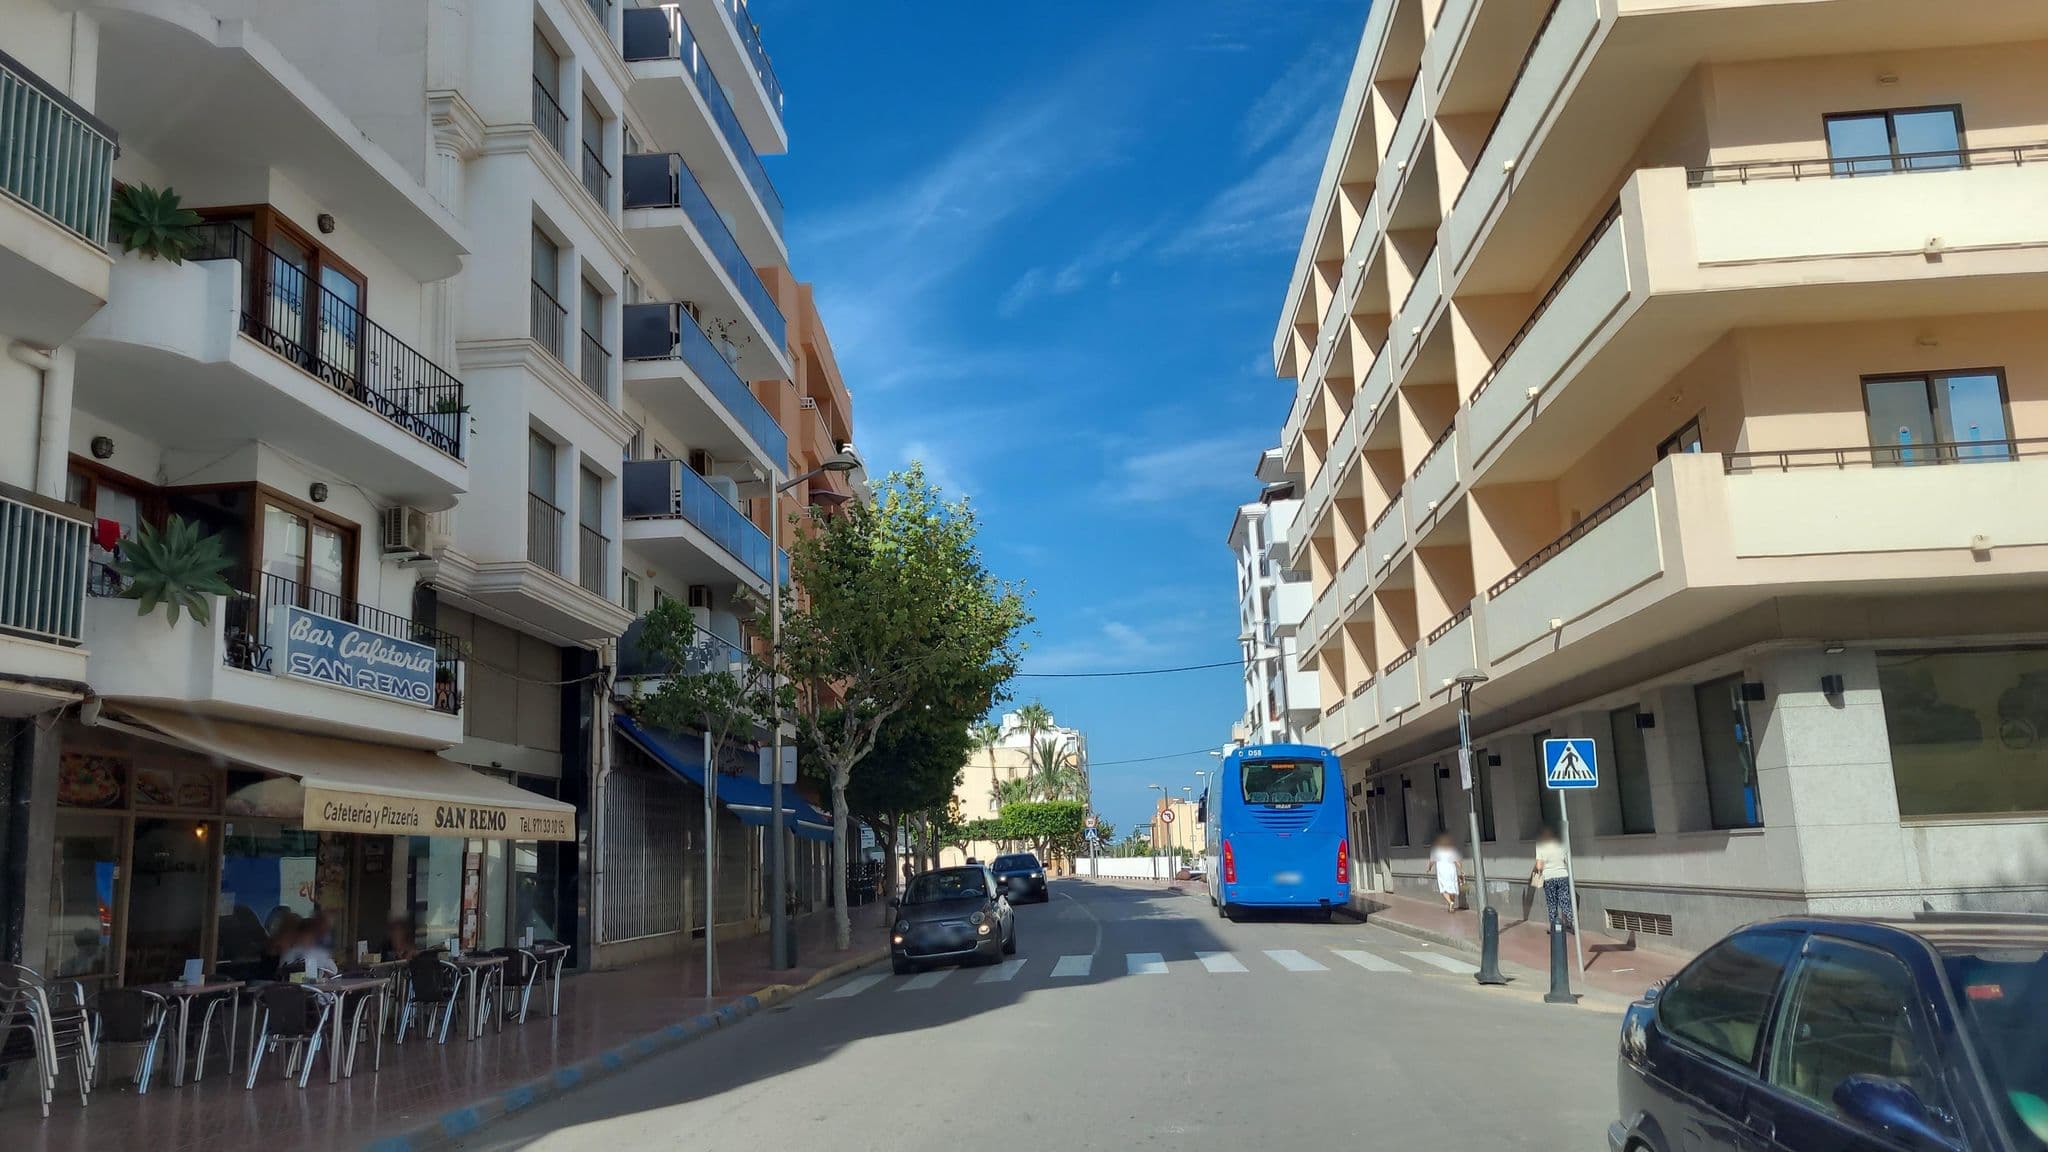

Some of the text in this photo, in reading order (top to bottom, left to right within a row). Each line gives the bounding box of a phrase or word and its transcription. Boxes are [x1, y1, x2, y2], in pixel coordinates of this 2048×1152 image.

[289, 616, 433, 673] Bar Cafetería
[288, 652, 431, 702] SAN REMO
[323, 801, 372, 824] Cafetería
[373, 809, 381, 829] y
[381, 806, 419, 826] Pizzería
[434, 806, 467, 829] SAN
[469, 809, 507, 832] REMO
